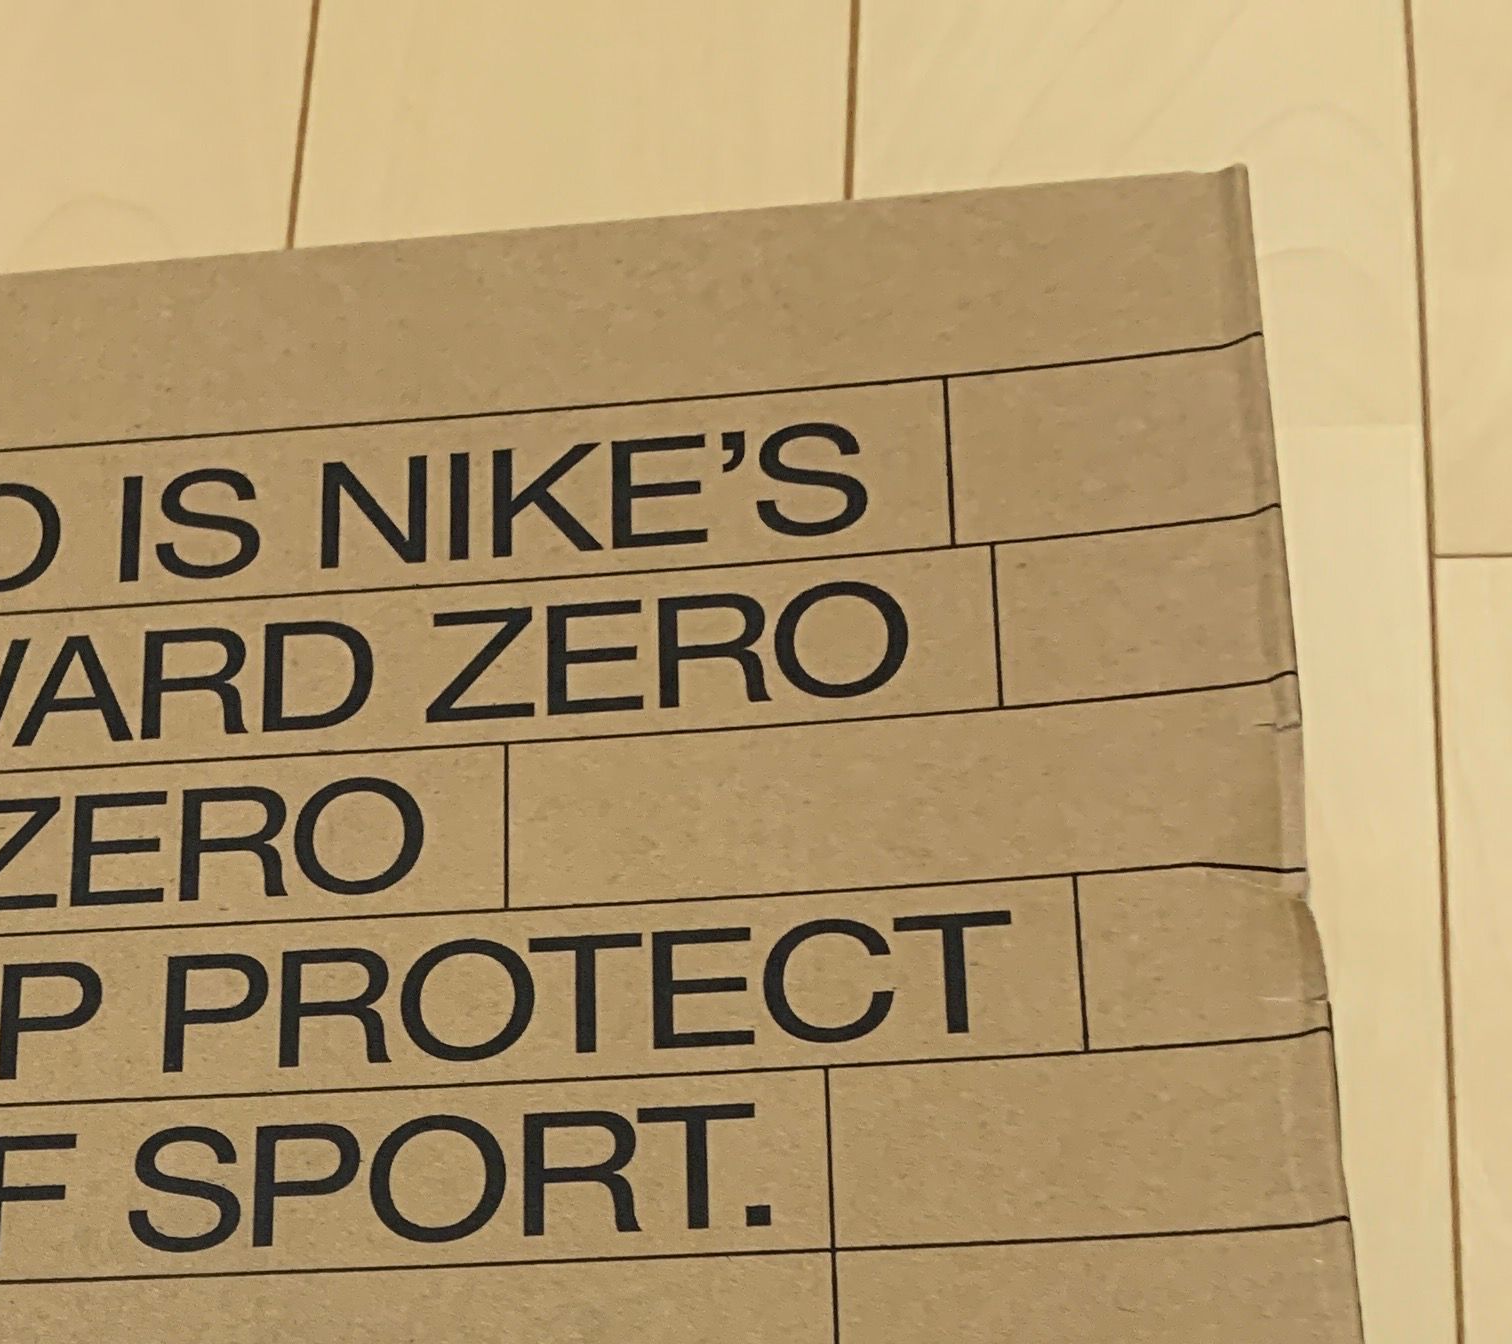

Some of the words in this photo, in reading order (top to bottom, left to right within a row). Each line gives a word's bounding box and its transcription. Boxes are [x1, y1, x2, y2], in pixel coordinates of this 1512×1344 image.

[119, 467, 261, 583] IS
[425, 580, 909, 724] ZERO
[162, 909, 1013, 1082] PROTECT
[128, 1102, 772, 1253] SPORT.
